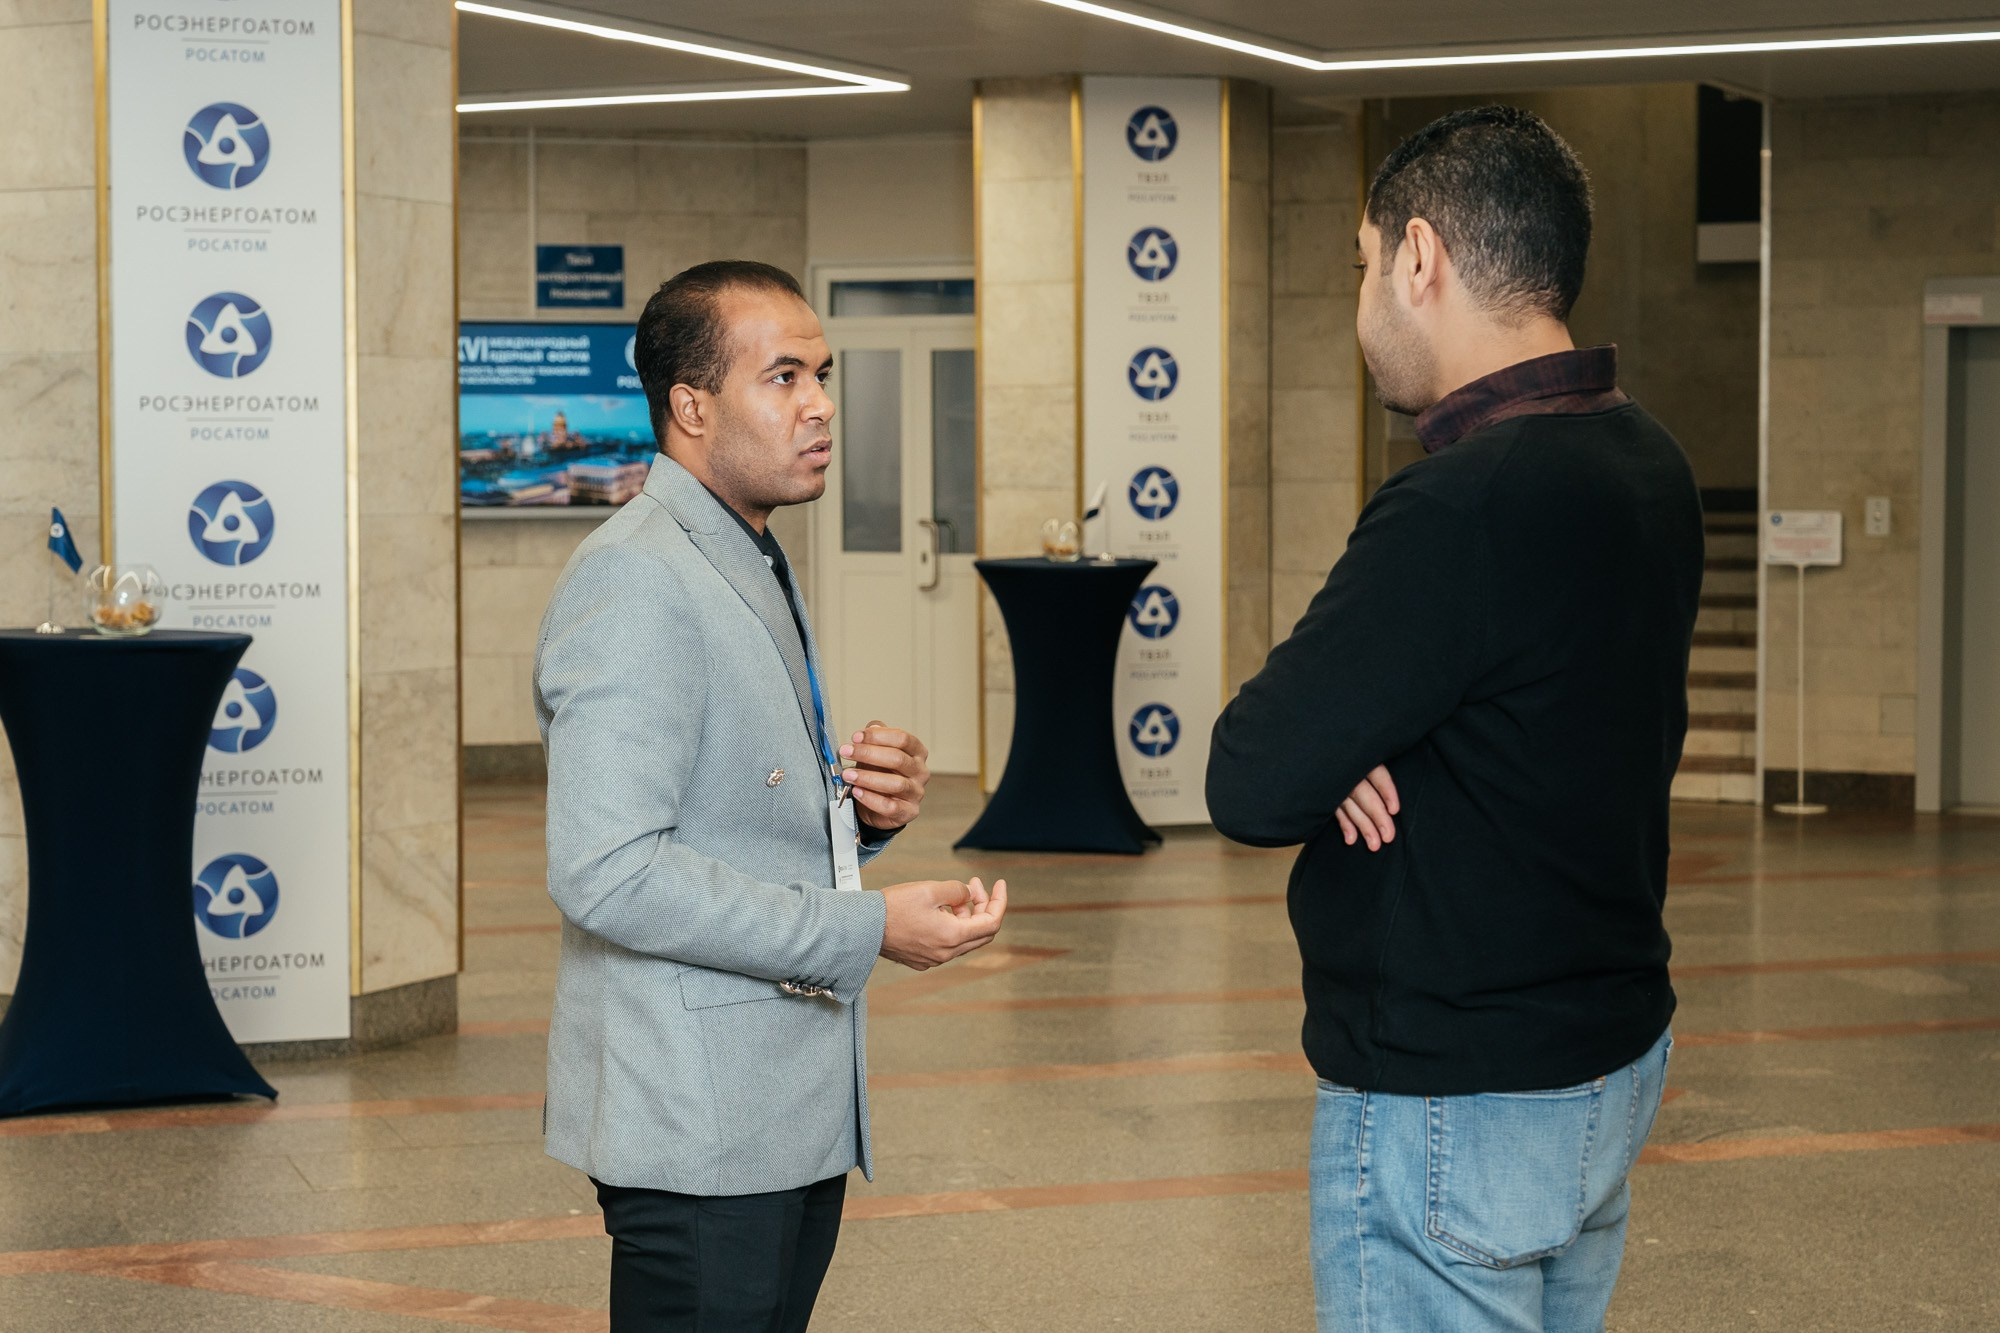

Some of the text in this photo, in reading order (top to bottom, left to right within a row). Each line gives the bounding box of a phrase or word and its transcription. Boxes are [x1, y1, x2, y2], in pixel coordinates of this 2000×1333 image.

[134, 14, 315, 36] РОСЭНЕРГОАТОМ
[185, 47, 266, 63] РОСАТОМ
[136, 205, 317, 225] РОСЭНЕРГОАТОМ
[188, 238, 268, 253] РОСАТОМ
[139, 394, 320, 413] РОСЭНЕРГОАТОМ
[190, 427, 270, 441] РОСАТОМ
[192, 615, 272, 628] РОСАТОМ
[200, 768, 323, 787] НЕРГОАТОМ
[203, 953, 325, 973] НЕРГОАТОМ
